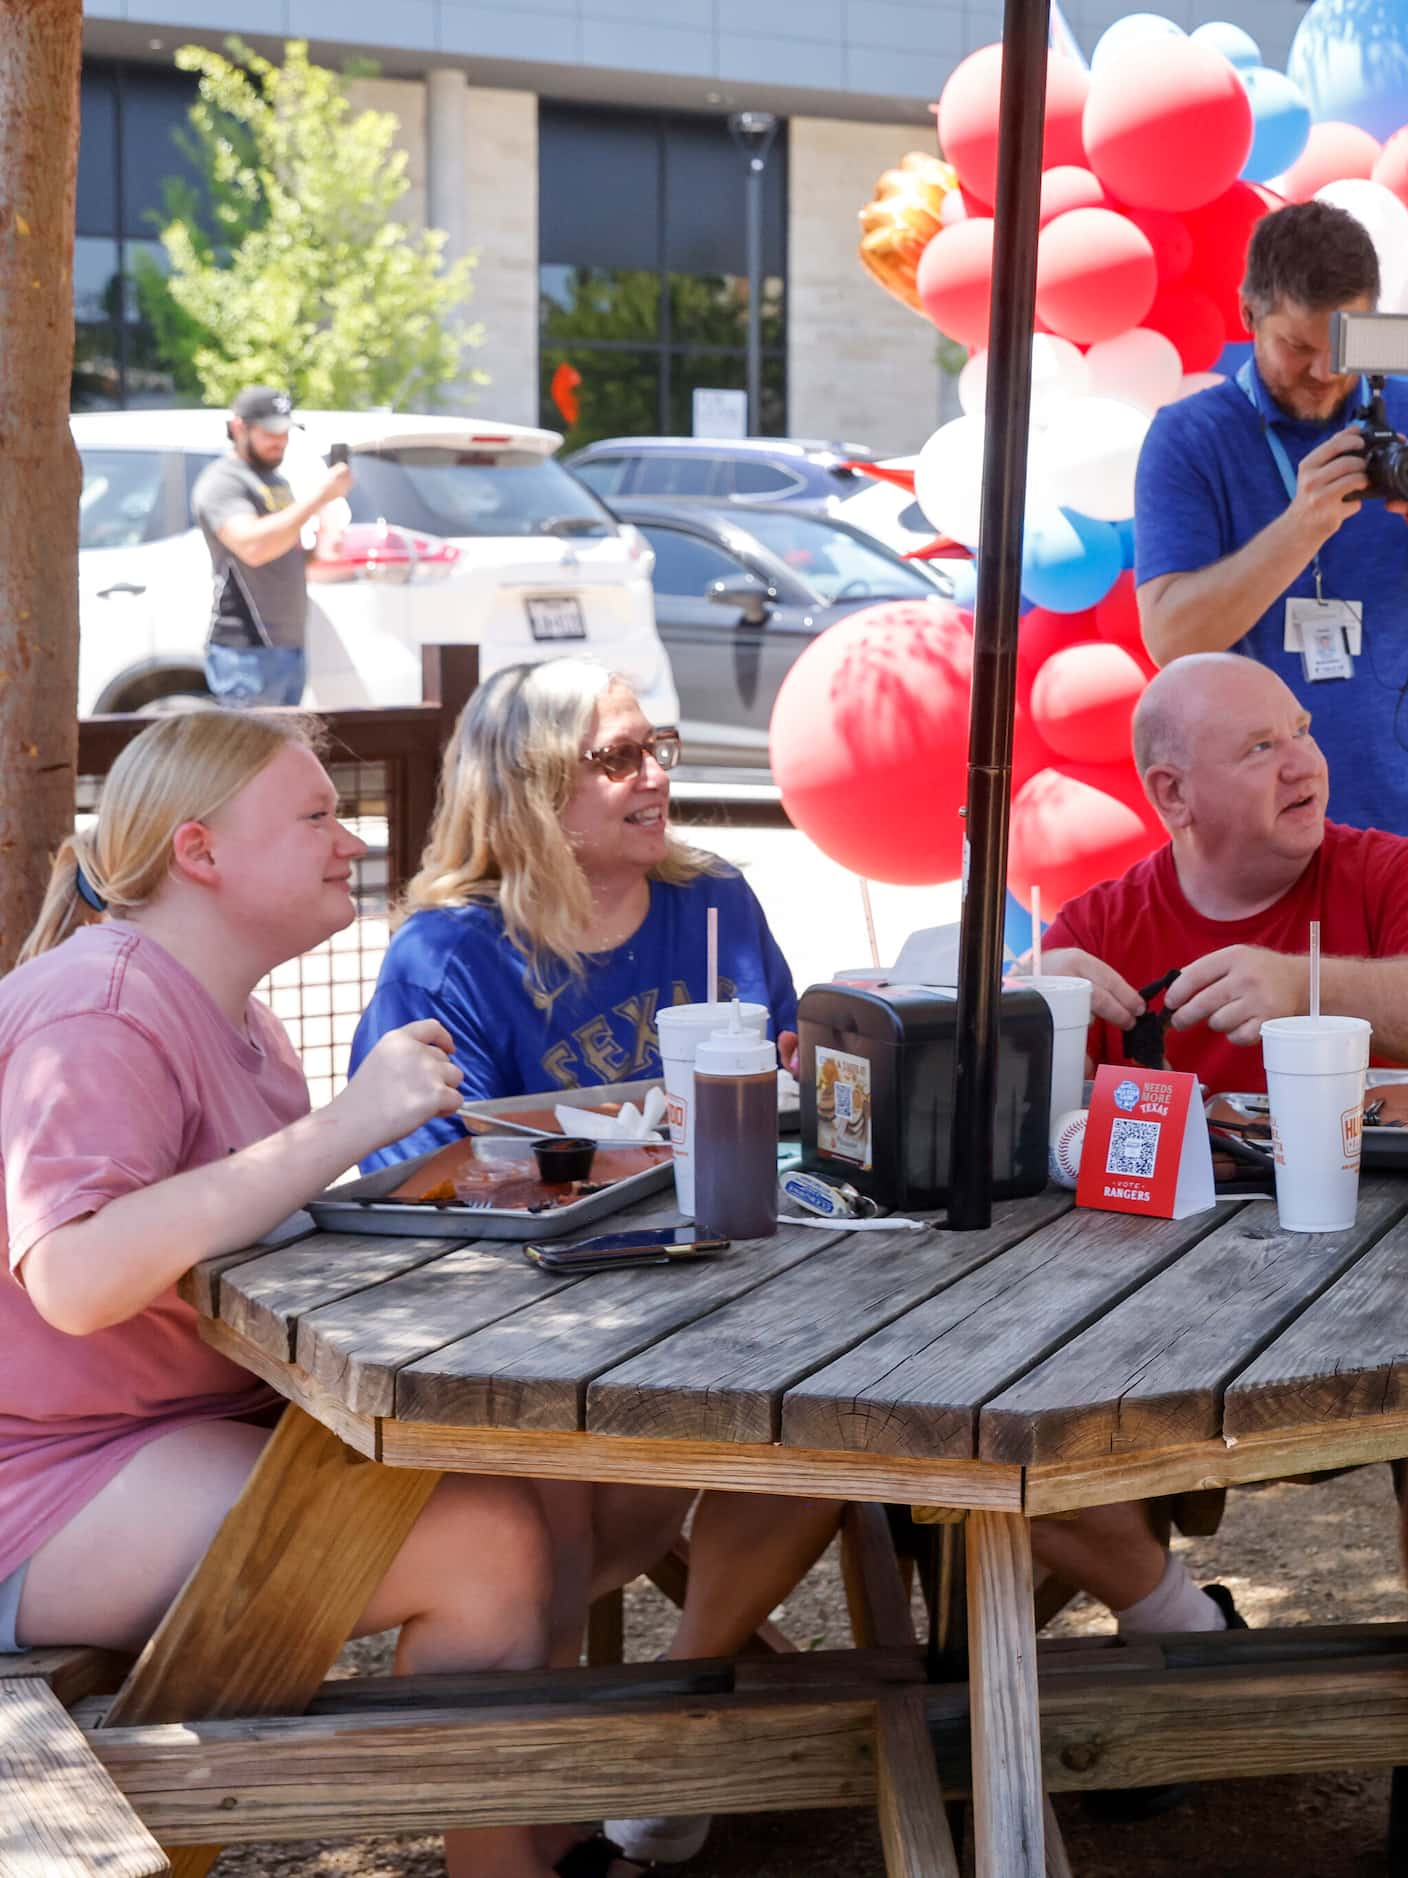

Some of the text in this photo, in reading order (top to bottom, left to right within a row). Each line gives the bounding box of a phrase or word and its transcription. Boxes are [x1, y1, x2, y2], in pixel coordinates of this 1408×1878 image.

[1143, 1082, 1174, 1094] NEEDS
[1142, 1092, 1172, 1104] MORE
[1140, 1102, 1168, 1116] TEXAS
[1103, 1186, 1151, 1202] RANGERS
